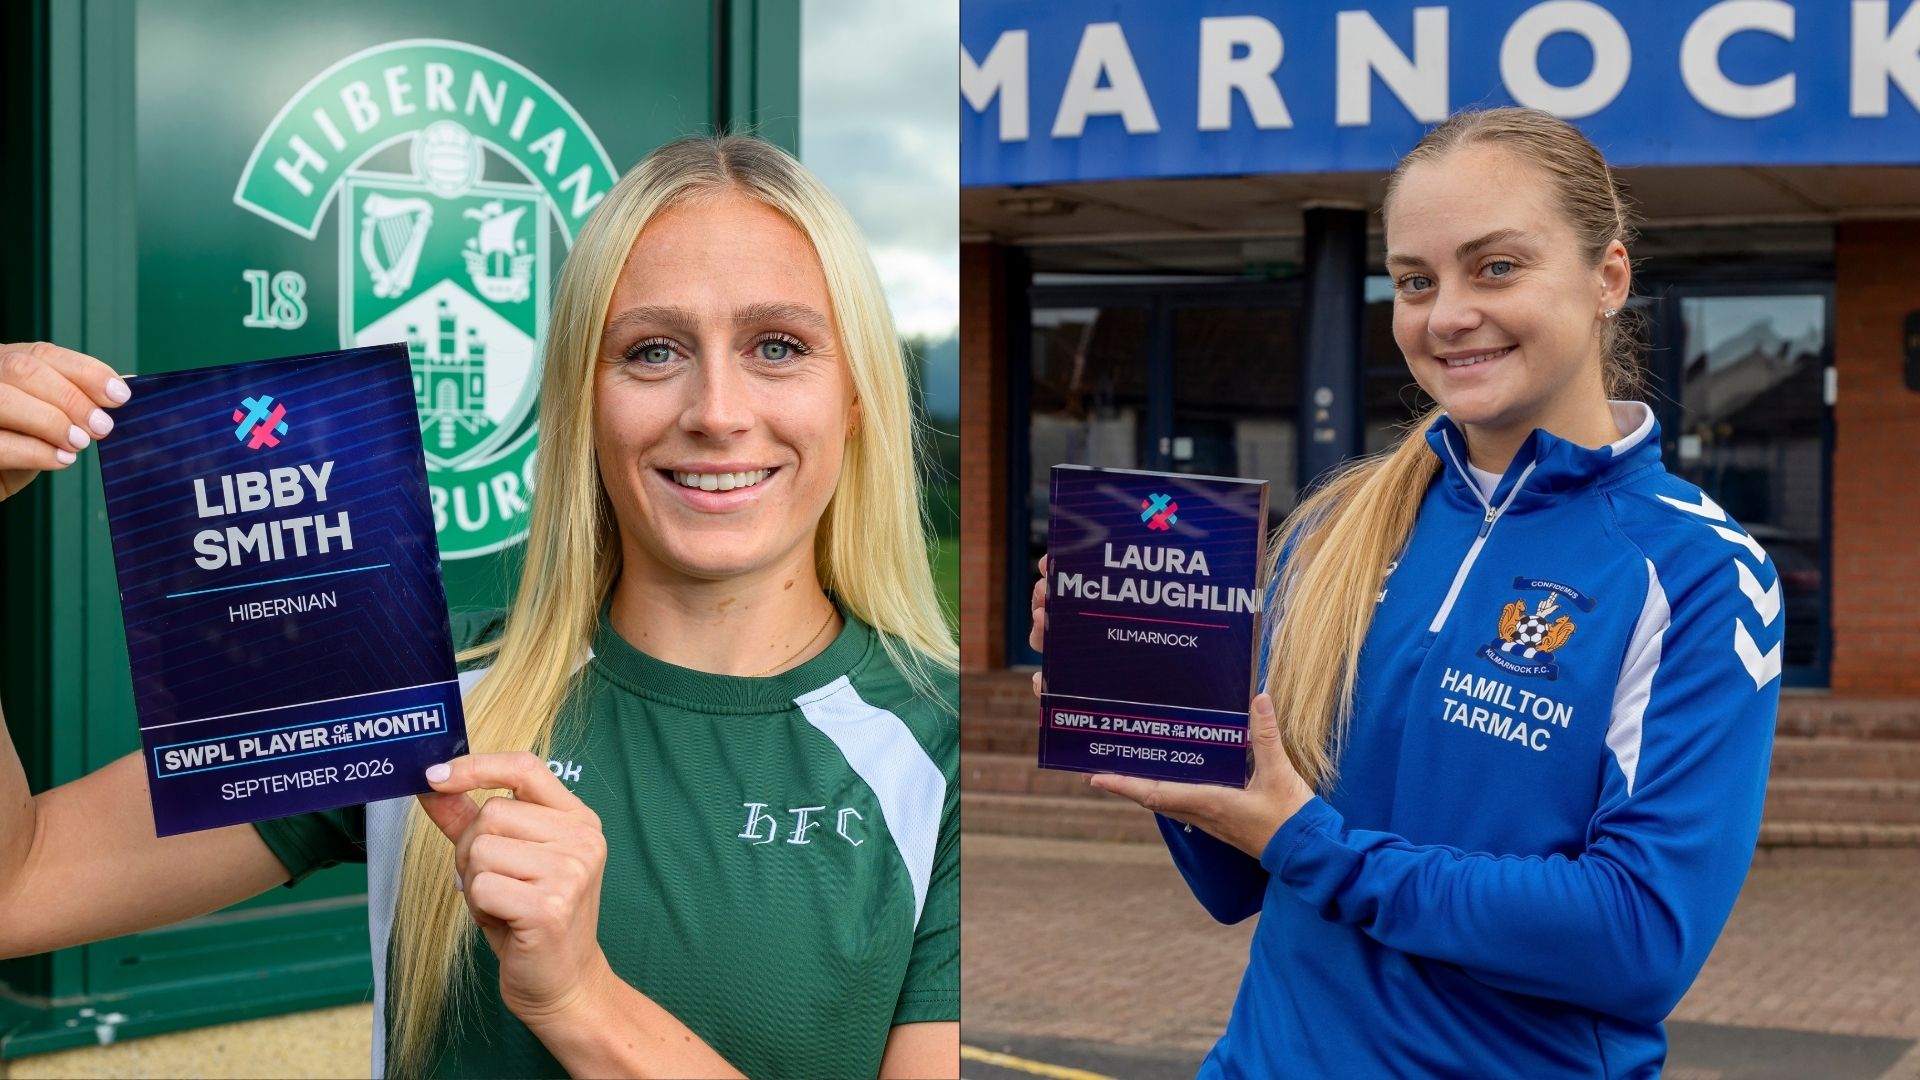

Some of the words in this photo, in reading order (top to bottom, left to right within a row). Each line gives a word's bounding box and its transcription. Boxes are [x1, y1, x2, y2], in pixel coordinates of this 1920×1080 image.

[273, 62, 605, 219] HIBERNIAN
[243, 269, 308, 330] 18
[194, 461, 334, 518] LIBBY
[193, 511, 353, 570] SMITH
[1104, 543, 1210, 576] LAURA
[1057, 572, 1256, 613] McLAUGHLIN
[1531, 581, 1579, 600] CONFIDEMUS
[229, 591, 337, 623] HIBERNIAN
[1107, 628, 1198, 648] KILMARNOCK
[1484, 648, 1532, 674] KILMARNOCK
[1533, 666, 1550, 674] F.C.
[1440, 668, 1573, 728] HAMILTON
[331, 732, 353, 744] THE
[333, 723, 349, 735] OF
[354, 709, 441, 741] MONTH
[1054, 713, 1098, 729] SWPL
[1101, 717, 1111, 730] 2
[1113, 718, 1170, 736] PLAYER
[1171, 730, 1186, 738] THE
[1186, 726, 1243, 744] MONTH
[1442, 698, 1551, 752] TARMAC
[164, 745, 235, 771] SWPL
[238, 727, 330, 759] PLAYER
[1089, 743, 1167, 762] SEPTEMBER
[1170, 751, 1205, 765] 2026
[221, 766, 339, 801] SEPTEMBER
[344, 758, 394, 781] 2026
